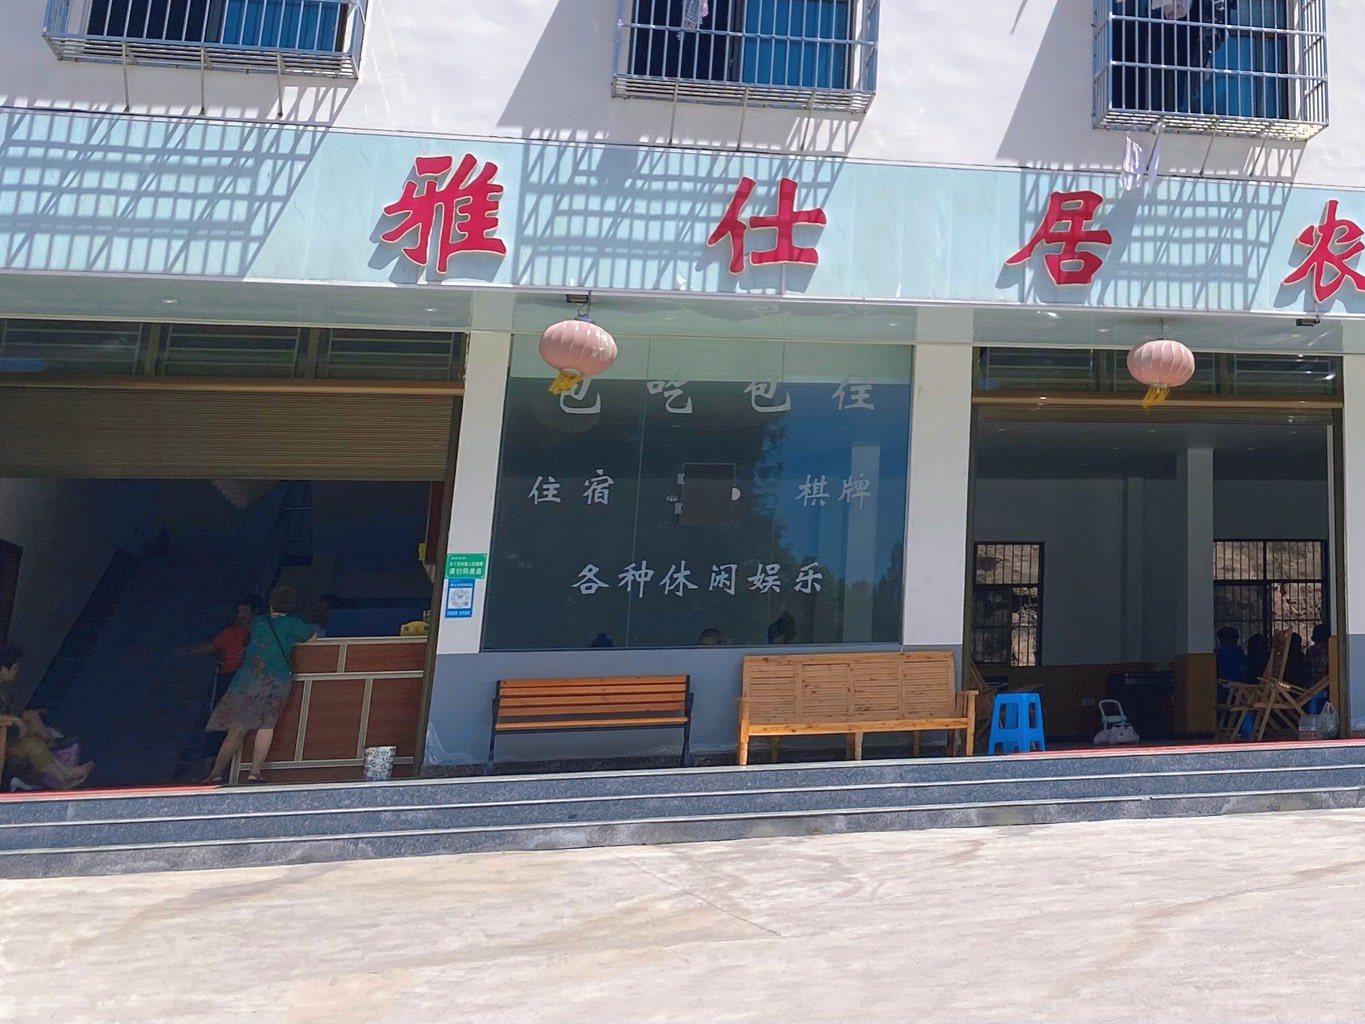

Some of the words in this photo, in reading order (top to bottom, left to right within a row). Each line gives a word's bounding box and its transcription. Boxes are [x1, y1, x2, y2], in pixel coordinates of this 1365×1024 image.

[527, 468, 616, 506] 住宿
[795, 473, 873, 510] 棋牌
[571, 560, 824, 599] 各种休闲娱乐
